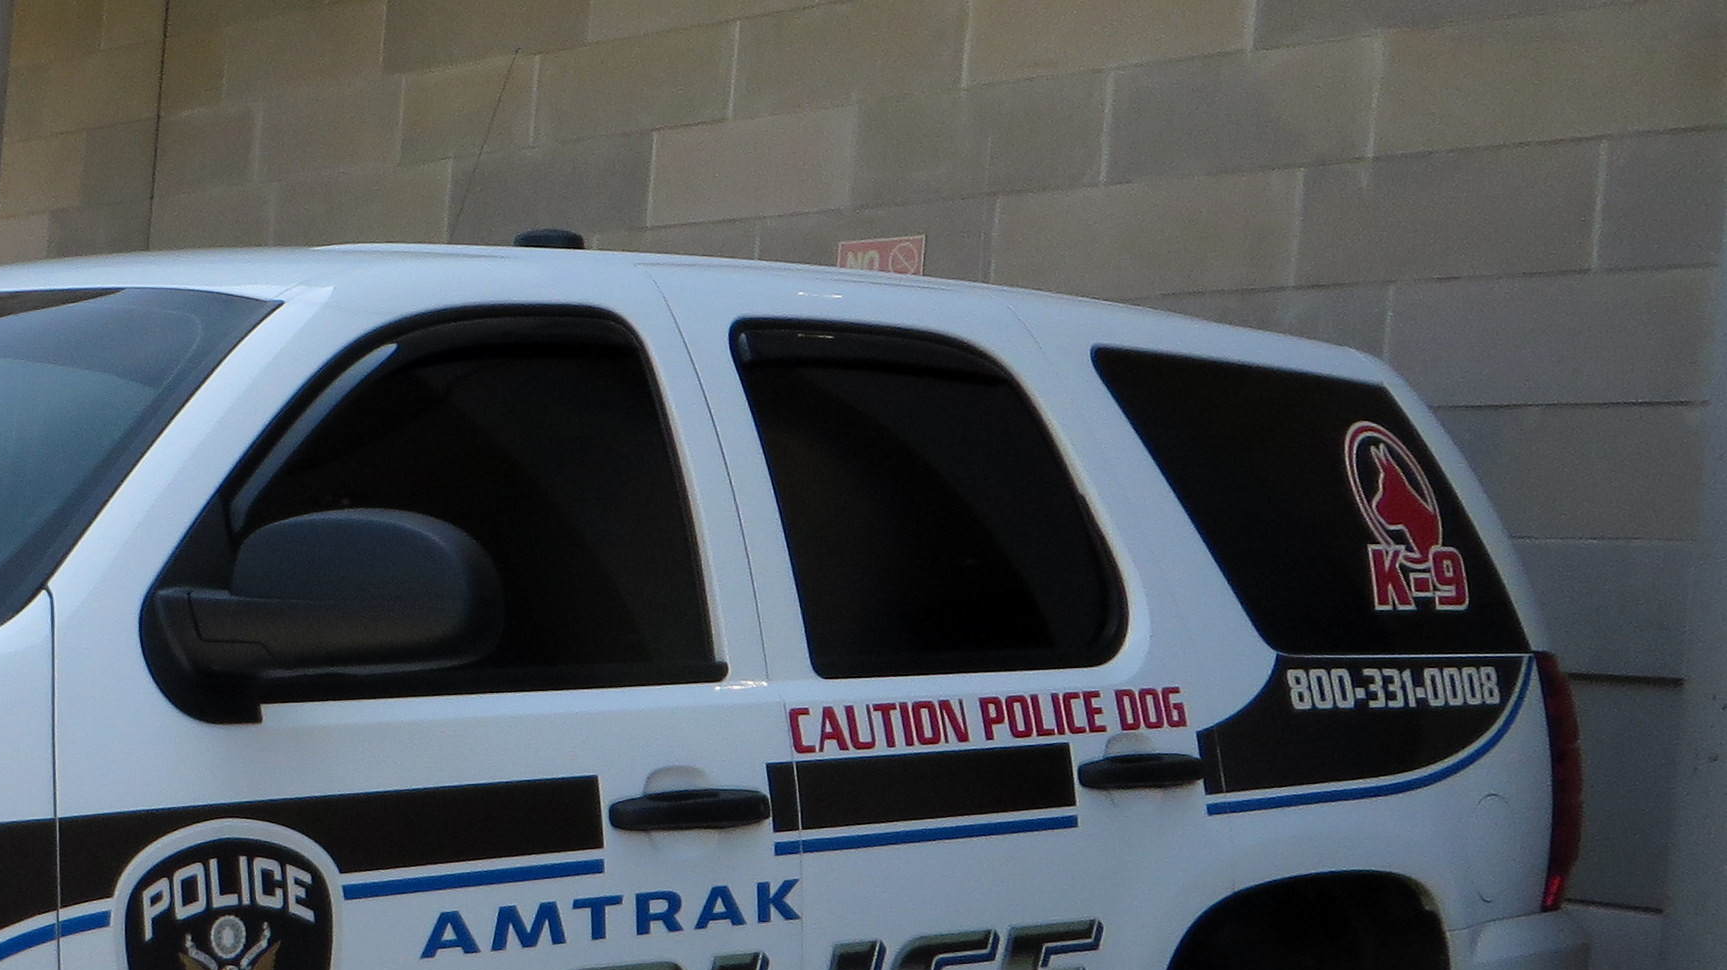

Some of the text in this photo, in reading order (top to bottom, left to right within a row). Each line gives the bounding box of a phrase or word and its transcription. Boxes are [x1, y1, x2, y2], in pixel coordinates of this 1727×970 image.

[1368, 544, 1469, 611] K-9
[788, 686, 1188, 754] CAUTION POLICE DOG
[1287, 666, 1500, 709] 800-331-0008
[142, 856, 315, 942] POLICE
[420, 878, 801, 959] AMTRAK
